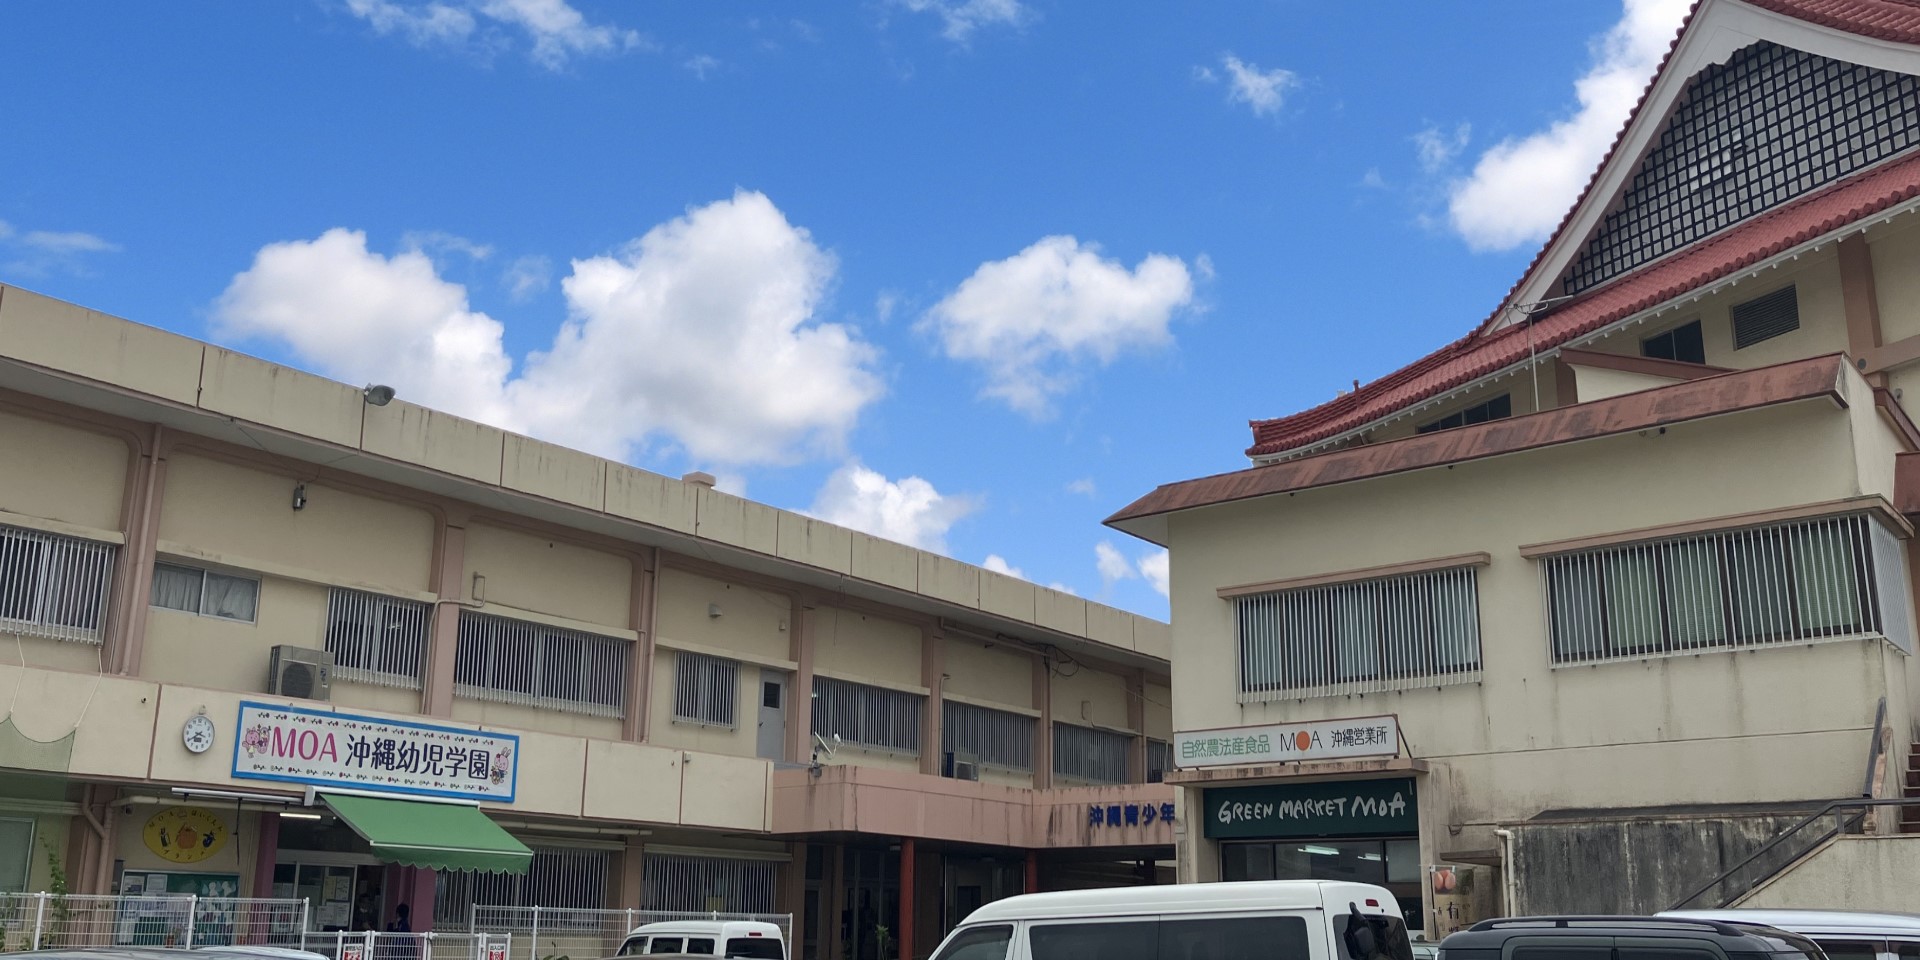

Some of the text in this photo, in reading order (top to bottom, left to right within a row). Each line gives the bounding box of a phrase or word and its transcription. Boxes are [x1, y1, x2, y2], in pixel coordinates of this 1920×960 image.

[271, 726, 490, 780] MOA 沖縄幼児学園
[1182, 733, 1270, 760] 自然農法産食品
[1331, 726, 1387, 748] 沖縄営業所
[1089, 802, 1175, 828] 沖縄青少年
[1217, 800, 1273, 825] GREEN
[1278, 797, 1348, 820] MARKET
